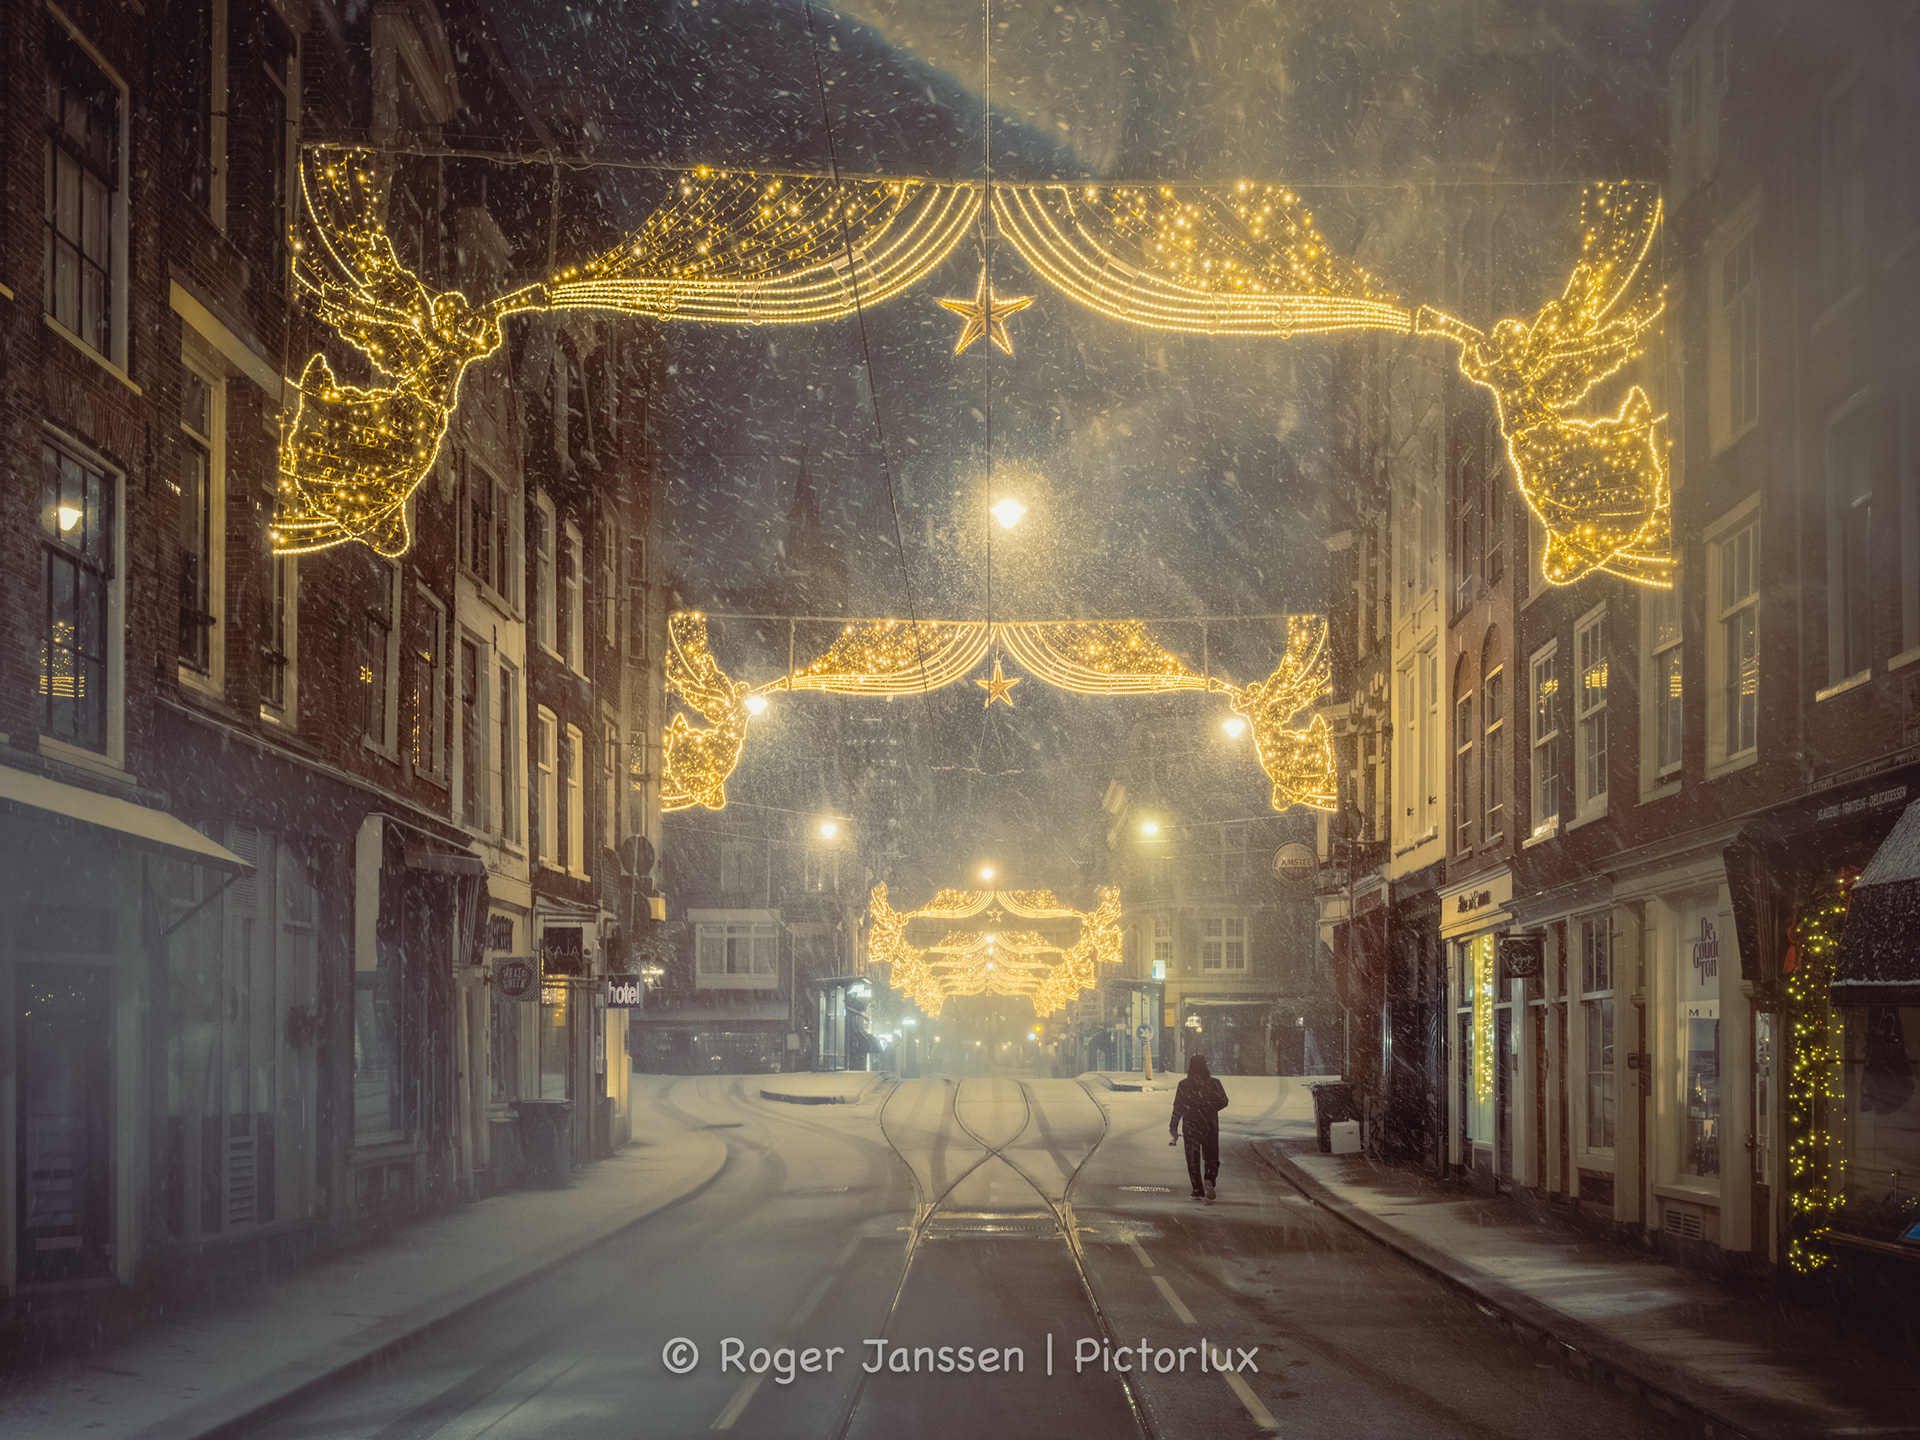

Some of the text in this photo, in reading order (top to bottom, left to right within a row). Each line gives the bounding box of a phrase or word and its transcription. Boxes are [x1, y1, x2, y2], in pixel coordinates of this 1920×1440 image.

[1842, 798, 1866, 814] TRAITEUR
[1869, 785, 1907, 807] DELICATESSEN
[1701, 917, 1713, 942] De
[546, 946, 580, 956] KAJA
[1700, 959, 1717, 986] Ton
[608, 981, 640, 1004] hotel
